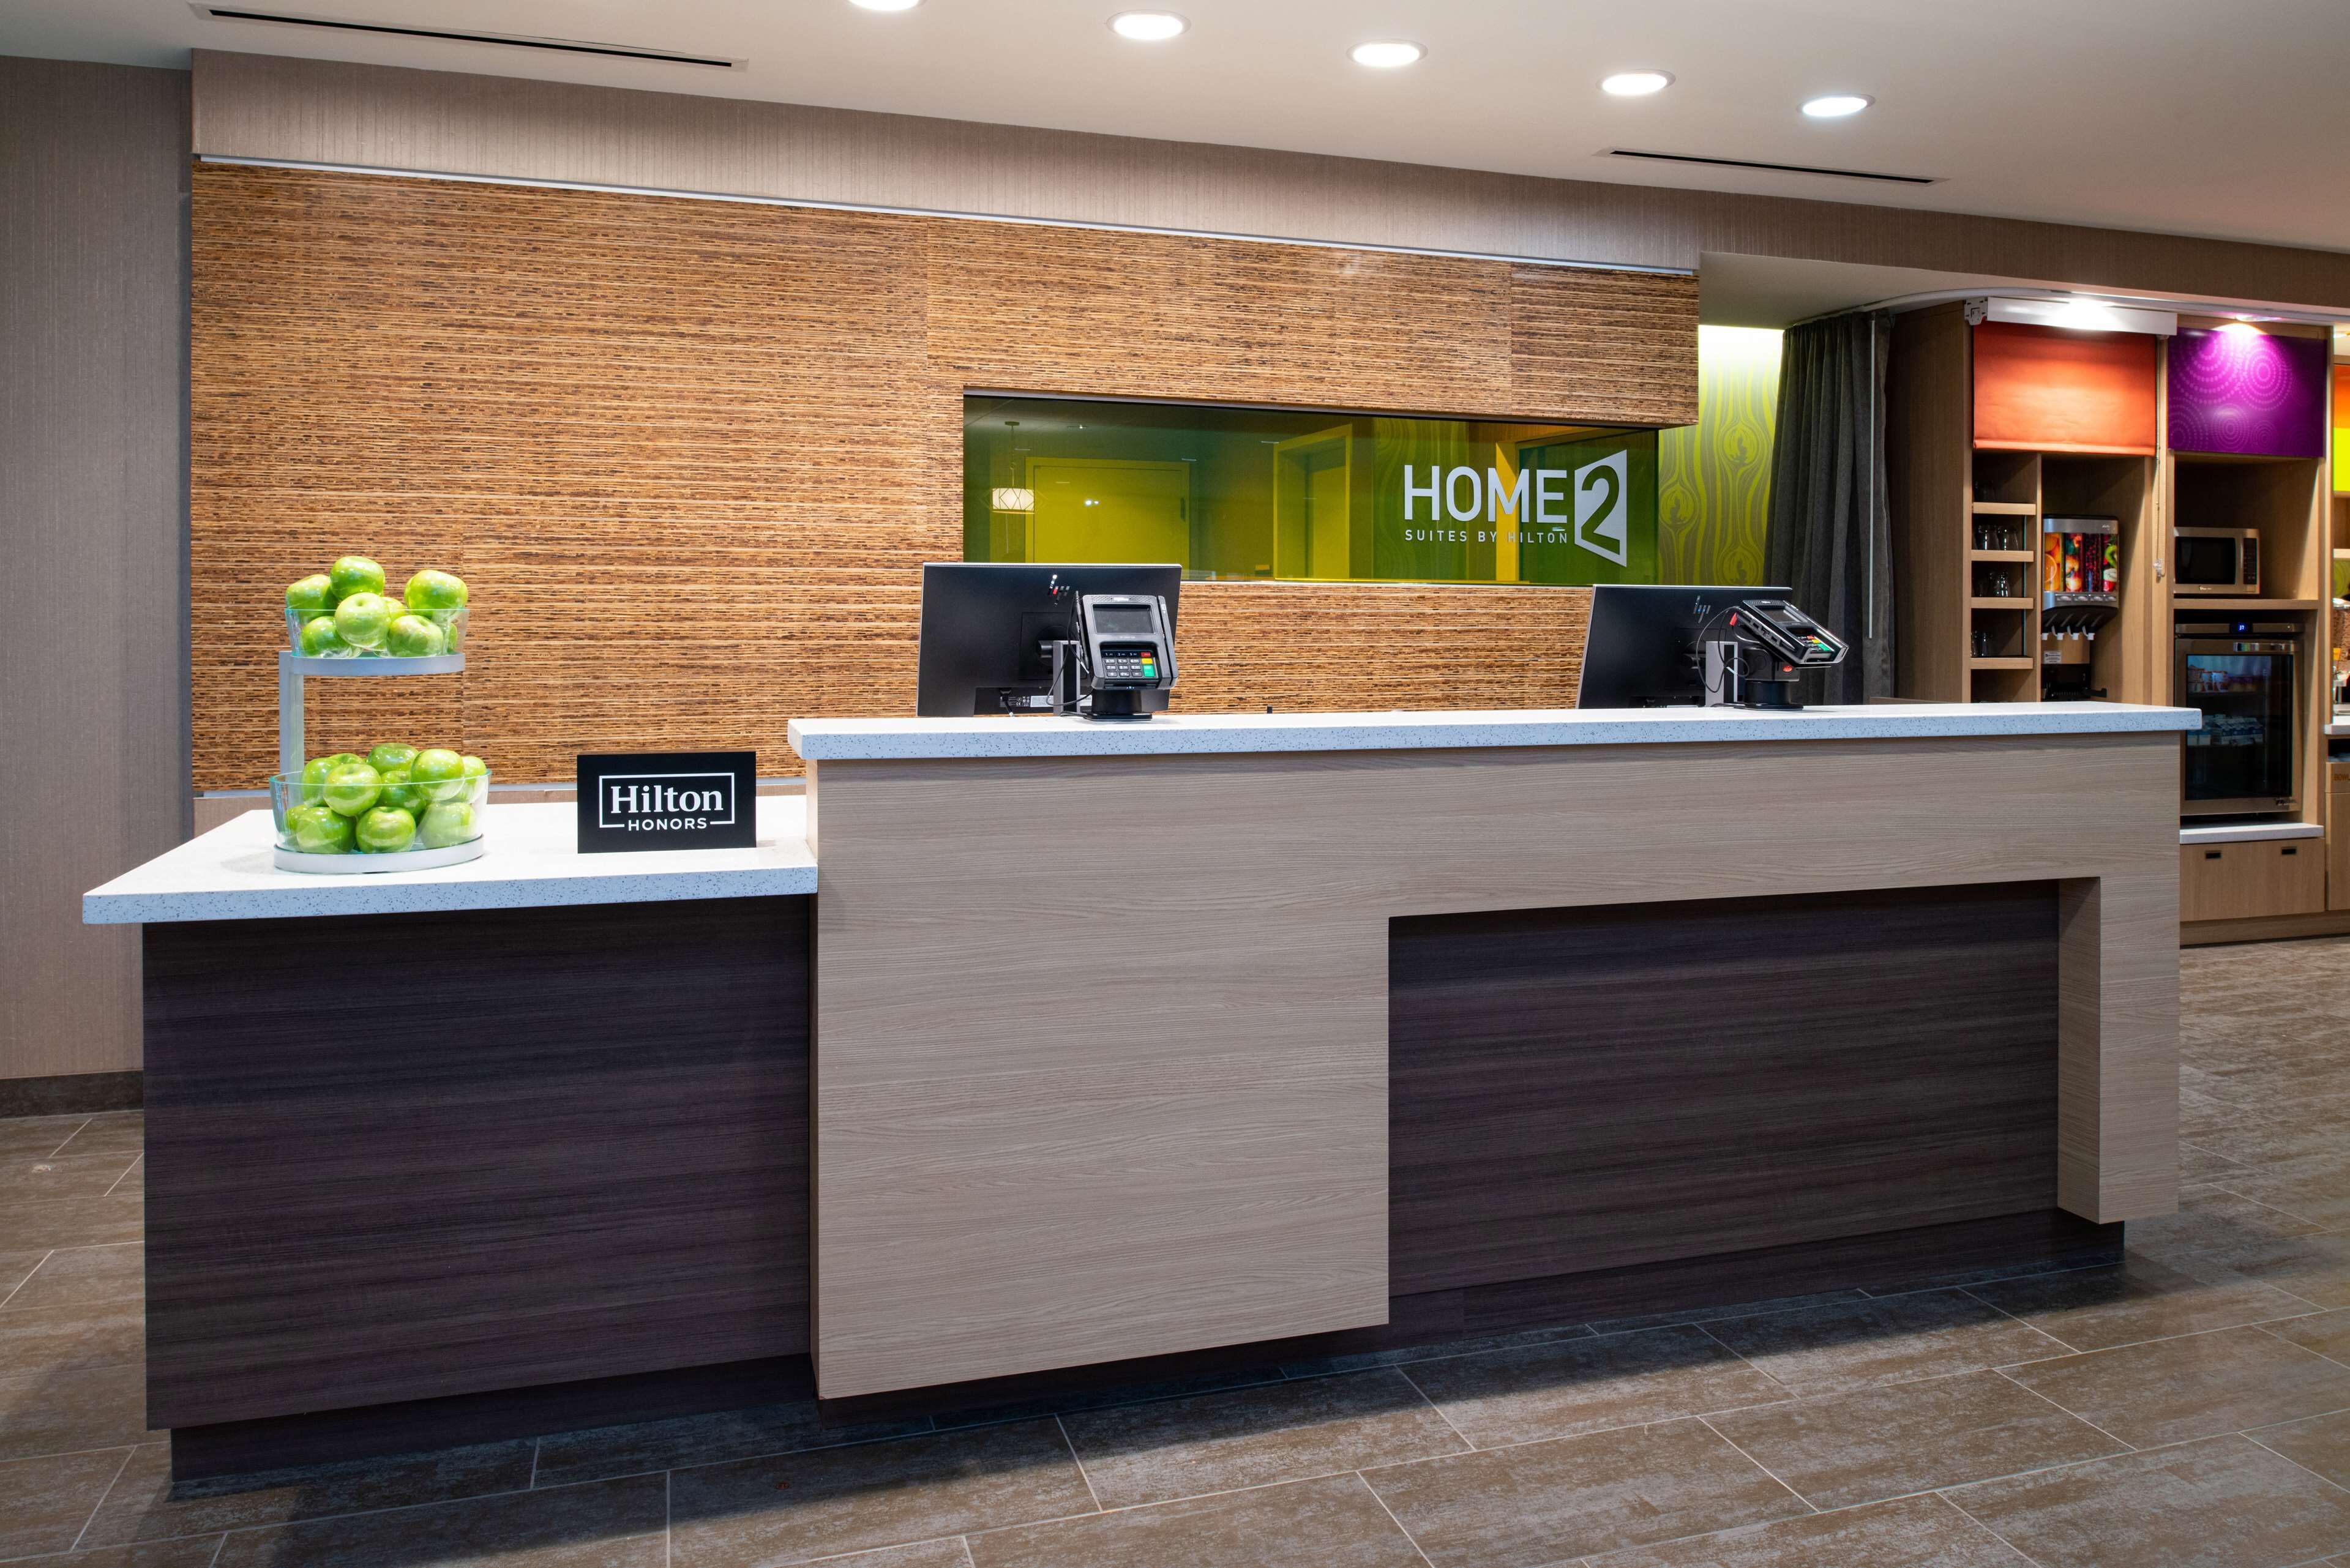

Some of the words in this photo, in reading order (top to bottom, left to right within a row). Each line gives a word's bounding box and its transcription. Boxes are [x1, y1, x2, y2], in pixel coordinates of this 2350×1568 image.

[1405, 529, 1467, 542] SUITES
[1478, 531, 1497, 543] BY
[1508, 532, 1568, 544] HILTON
[611, 785, 724, 813] Hilton
[628, 818, 707, 831] HONORS
